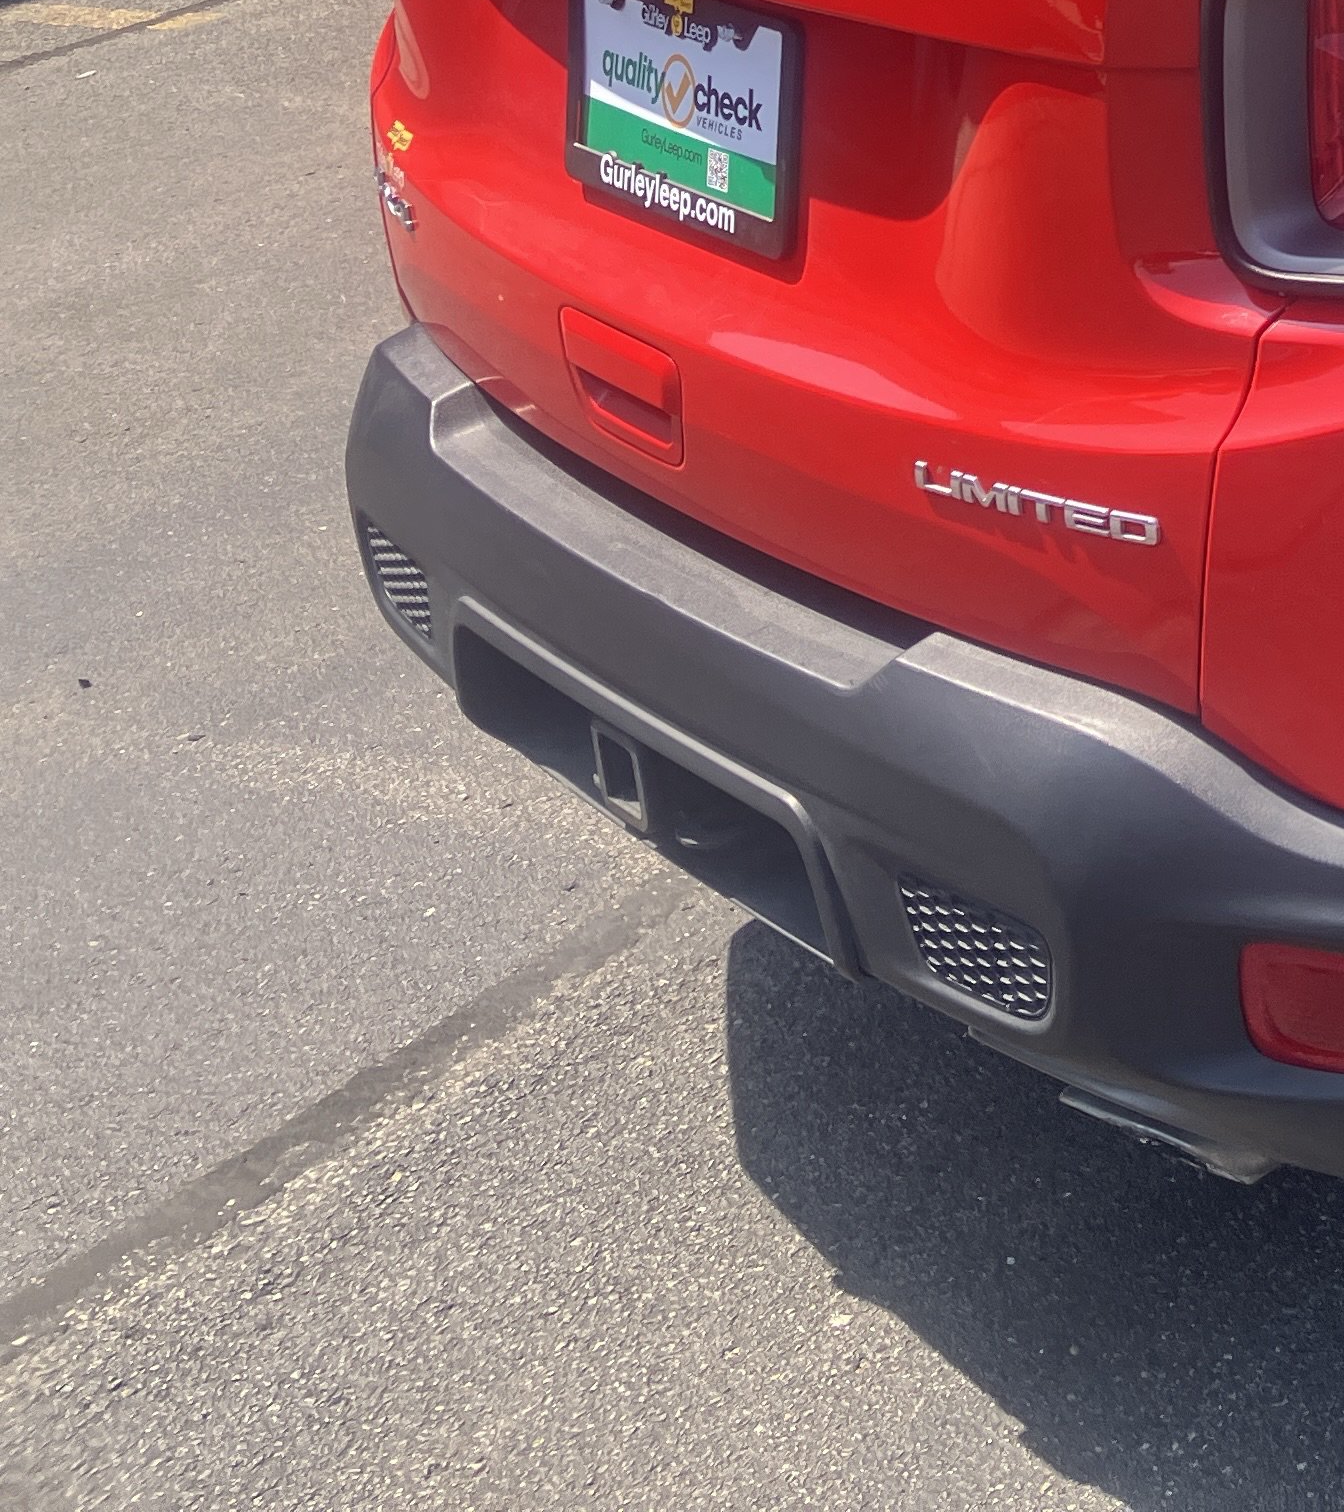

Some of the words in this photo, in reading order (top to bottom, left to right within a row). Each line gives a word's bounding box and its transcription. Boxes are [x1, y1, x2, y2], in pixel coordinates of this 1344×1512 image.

[602, 49, 665, 104] quality
[694, 75, 763, 132] check
[696, 116, 743, 141] VEHICLES
[600, 152, 735, 234] Gurleyleep.com
[914, 460, 1160, 546] LIMITED
